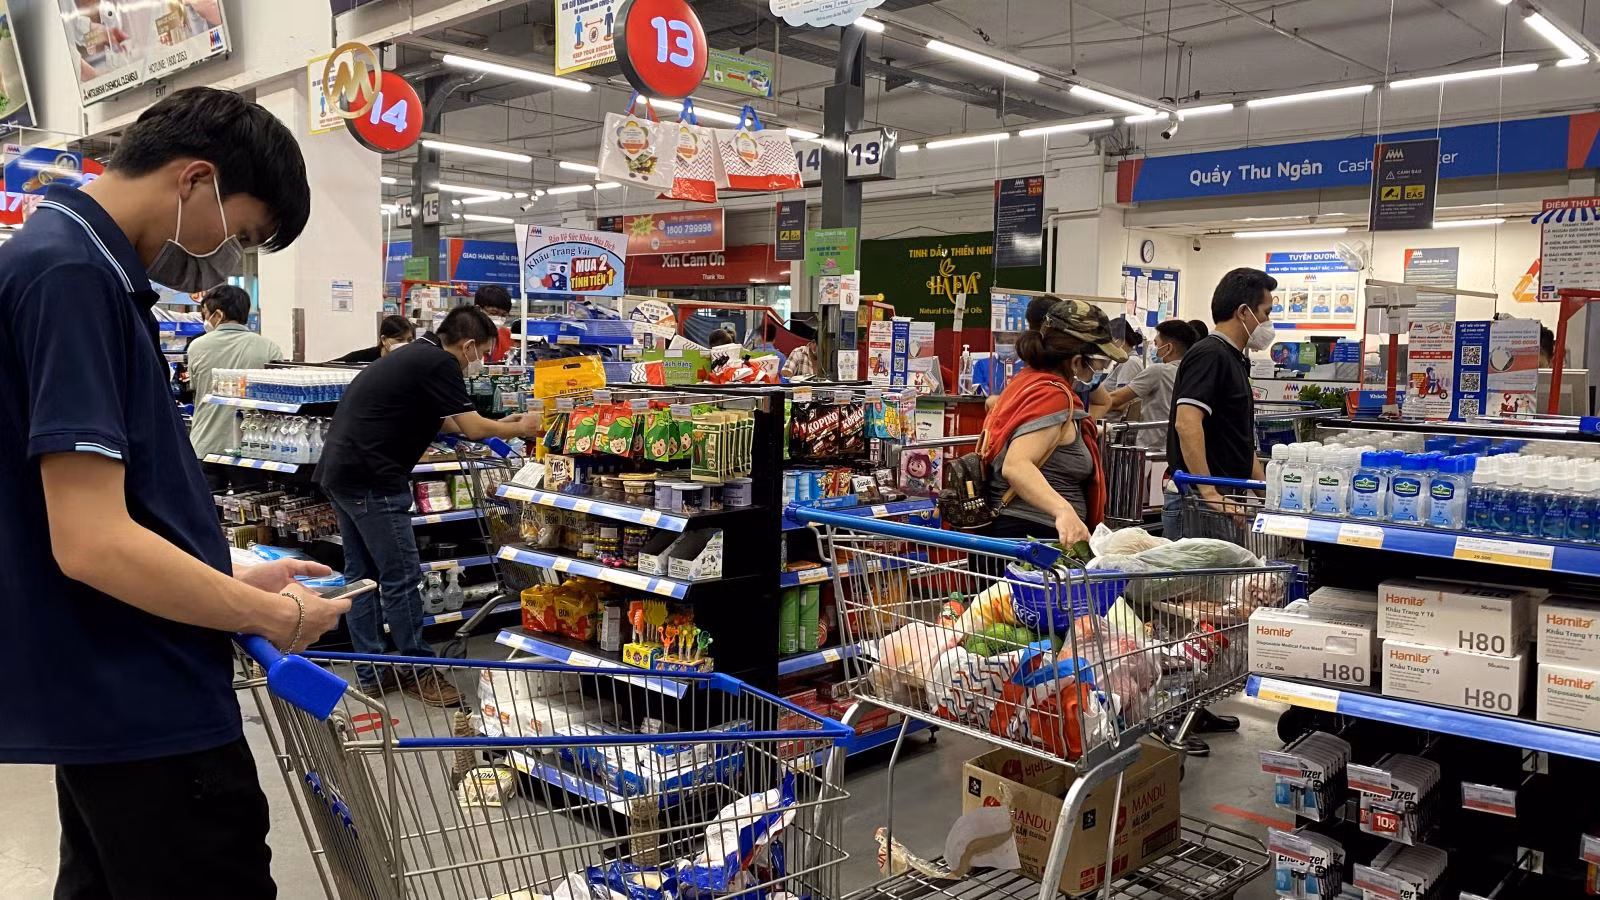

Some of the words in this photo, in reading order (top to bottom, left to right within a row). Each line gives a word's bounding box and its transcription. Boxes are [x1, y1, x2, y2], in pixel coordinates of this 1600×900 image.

[596, 43, 614, 52] DISTANC
[651, 16, 695, 68] 13
[155, 85, 167, 98] EXIT
[370, 92, 408, 133] 14
[851, 142, 880, 166] 13
[1190, 164, 1231, 187] Quầy
[1239, 164, 1271, 181] Thu
[1278, 159, 1322, 181] Ngân
[1406, 191, 1424, 199] EAS
[424, 200, 439, 216] 15
[1571, 199, 1590, 208] THU
[1592, 198, 1600, 206] TI
[667, 224, 683, 235] 1800
[909, 249, 927, 258] TINH
[930, 243, 948, 257] DẦU
[977, 245, 994, 255] NHI
[527, 250, 550, 271] Khẩu
[551, 246, 576, 257] Trang
[578, 246, 590, 256] Vải
[576, 258, 597, 273] MUA
[599, 253, 609, 271] 2
[662, 254, 680, 268] Xin
[571, 275, 589, 289] TÍNH
[590, 272, 606, 287] TIỀN
[607, 268, 615, 286] 1
[716, 273, 725, 281] You
[920, 307, 941, 315] Natural
[808, 411, 838, 434] KOPIKO
[1386, 592, 1425, 607] Hamita
[1402, 608, 1419, 617] Trang
[1546, 614, 1593, 629] Hamita
[1256, 625, 1292, 638] Hamita
[1565, 630, 1585, 639] Trang
[1458, 630, 1505, 654] H80
[1390, 649, 1430, 664] Hamita
[1322, 662, 1365, 683] H80
[1407, 665, 1424, 673] Trang
[1547, 674, 1594, 690] Hamita
[1465, 687, 1512, 712] H80
[1547, 687, 1583, 699] Disposable
[1585, 694, 1600, 702] Med
[1132, 782, 1166, 813] MANDU
[1376, 815, 1395, 830] 10x
